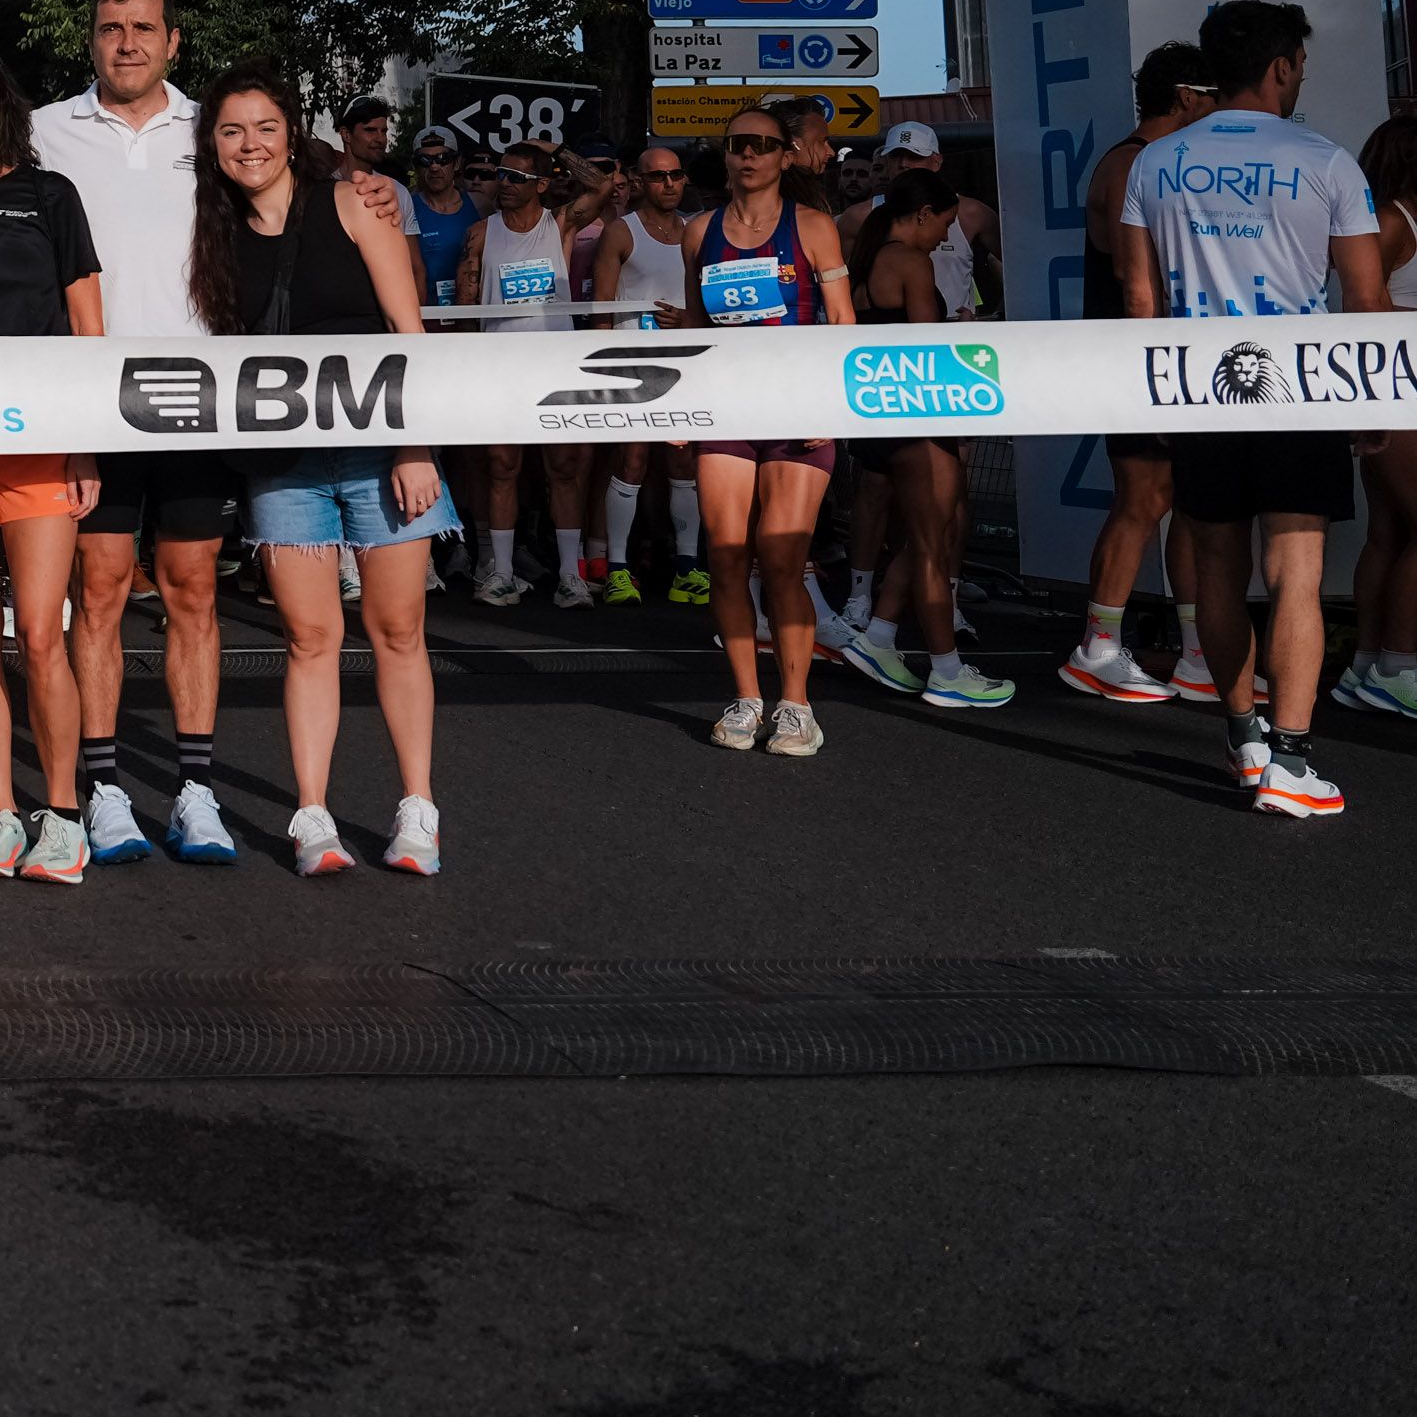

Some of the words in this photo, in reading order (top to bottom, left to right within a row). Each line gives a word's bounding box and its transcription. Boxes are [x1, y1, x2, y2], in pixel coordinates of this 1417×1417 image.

[653, 33, 722, 48] hospital
[654, 54, 678, 71] La
[685, 54, 722, 71] Paz
[657, 97, 696, 106] estación
[698, 96, 757, 106] Chamartín
[657, 115, 687, 125] Clara
[689, 115, 731, 126] Campo
[1158, 153, 1300, 206] NORTH
[1189, 220, 1221, 237] Run
[1226, 223, 1264, 239] Well
[505, 276, 554, 296] 5322
[723, 285, 759, 307] 83
[853, 353, 937, 384] SANI
[1143, 344, 1210, 406] EL
[235, 353, 408, 432] BM
[854, 381, 999, 414] CENTRO
[538, 411, 714, 430] SKECHERS
